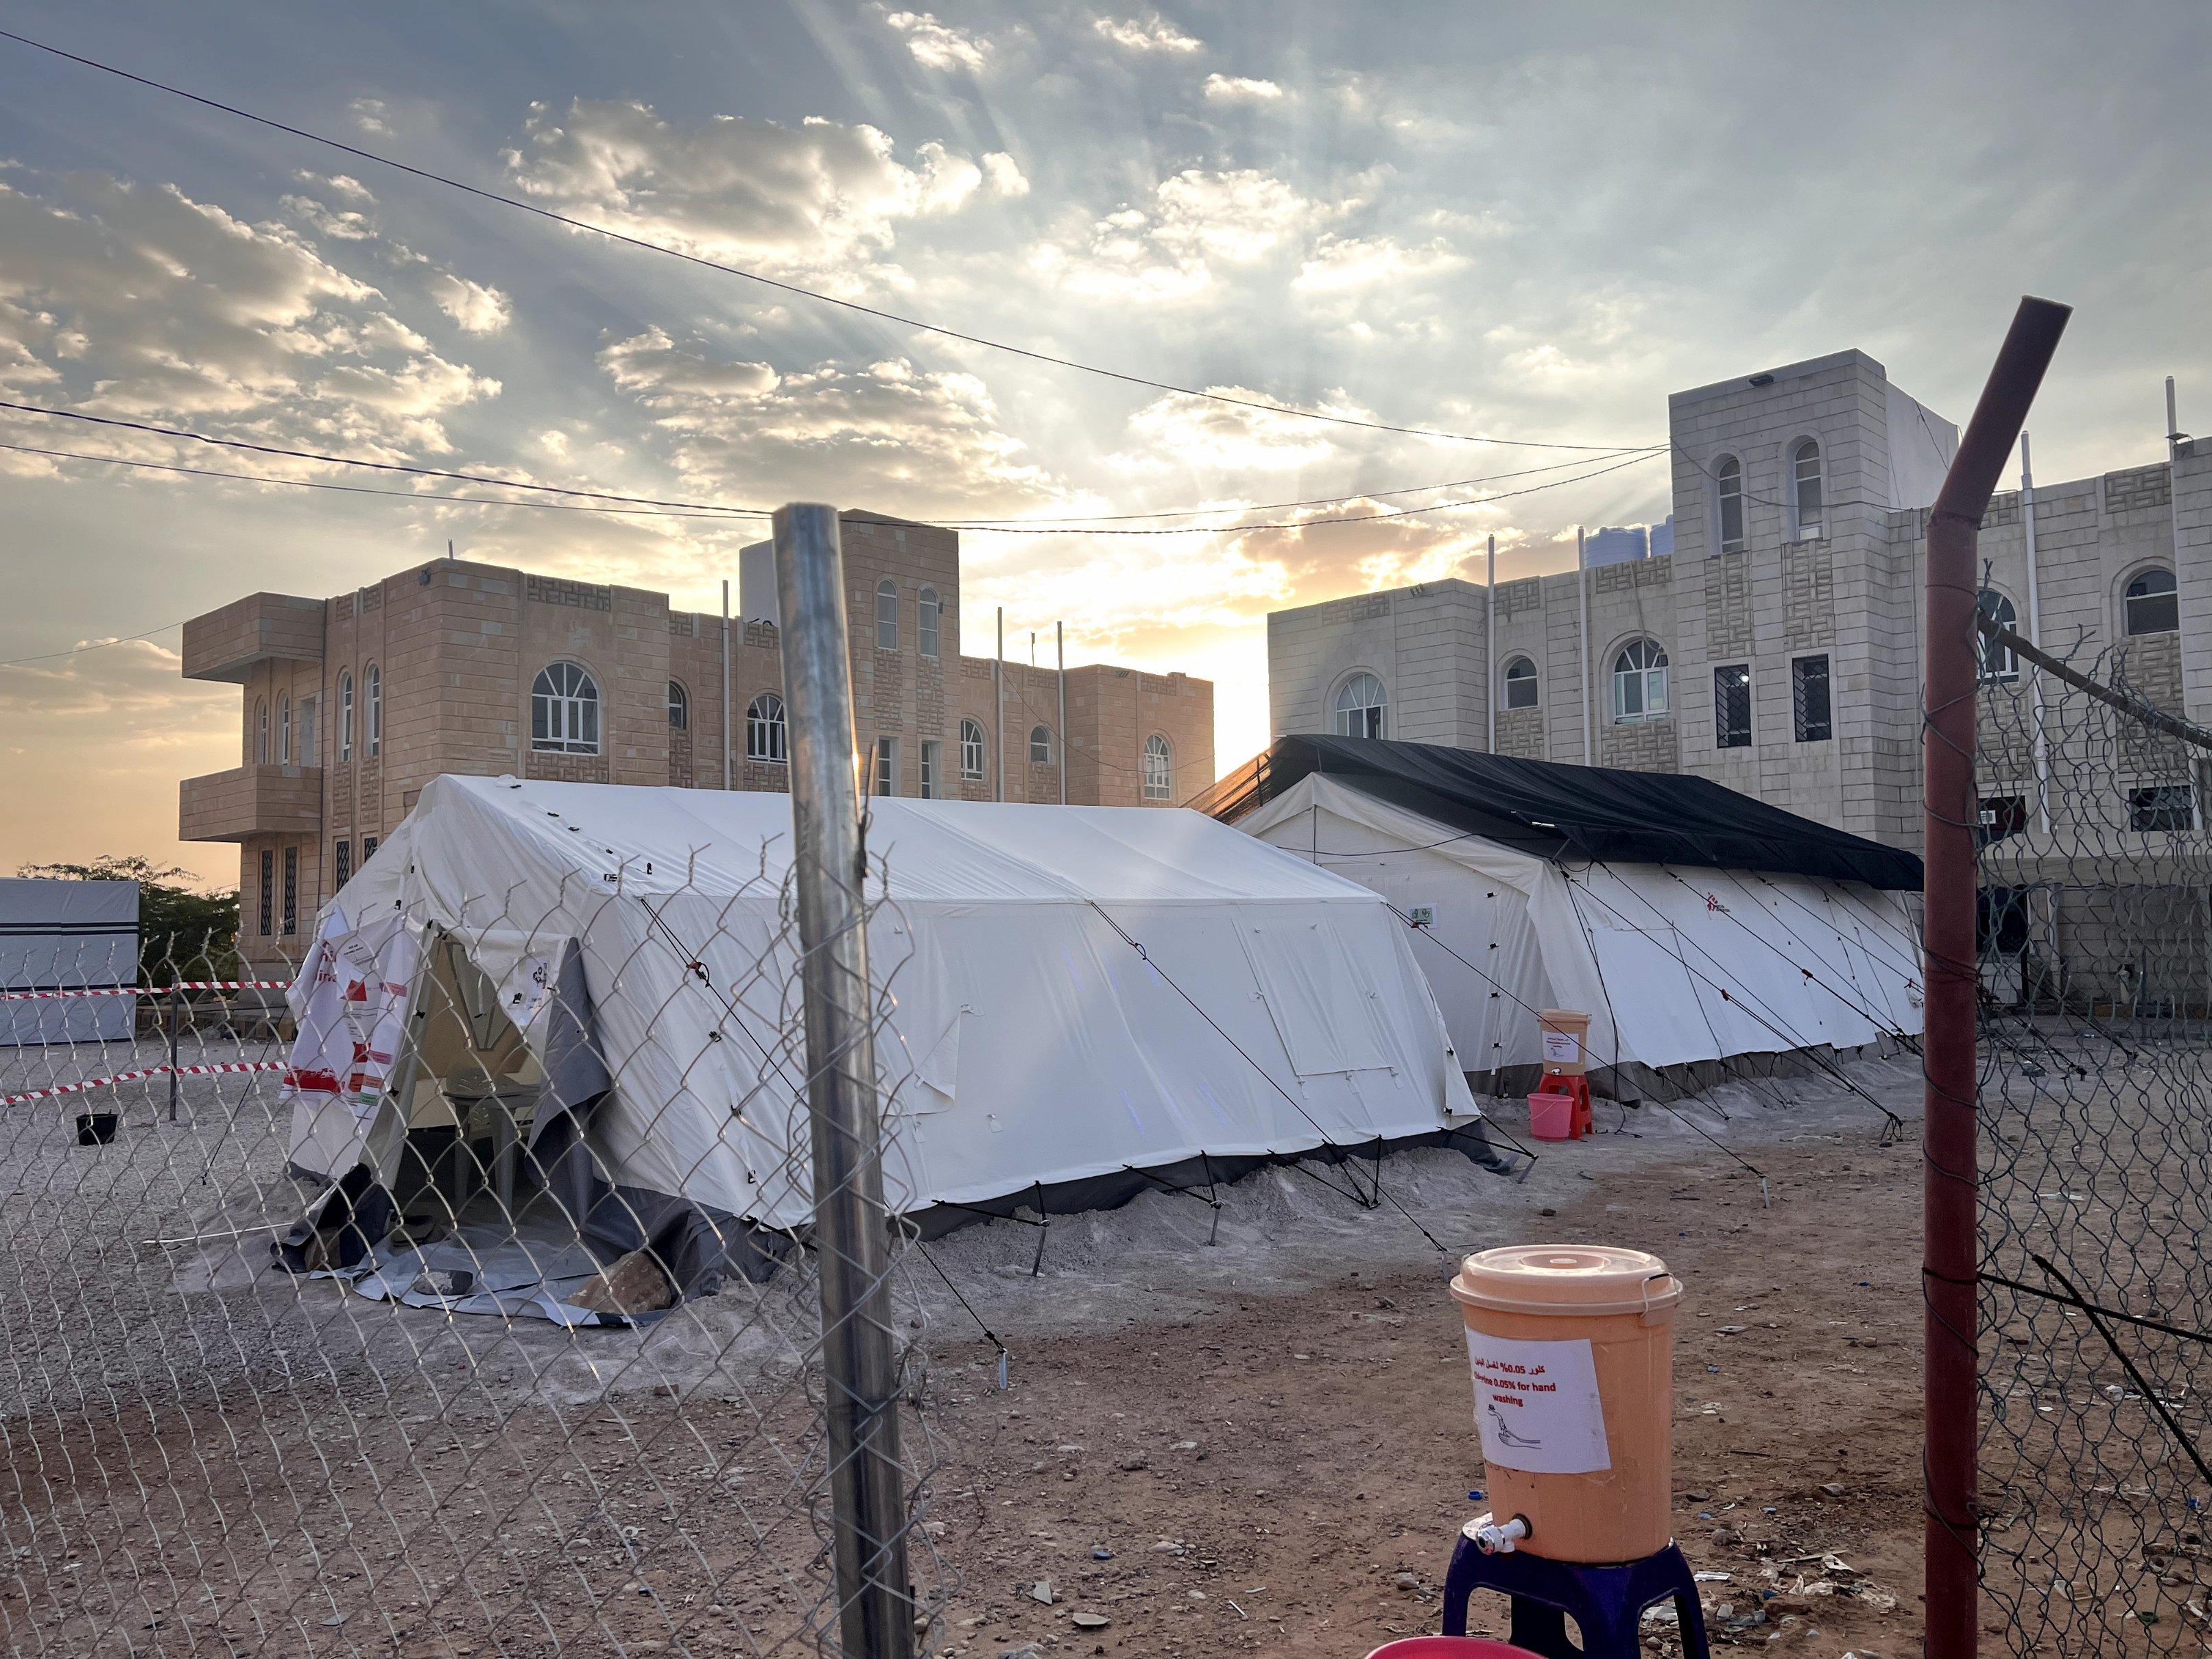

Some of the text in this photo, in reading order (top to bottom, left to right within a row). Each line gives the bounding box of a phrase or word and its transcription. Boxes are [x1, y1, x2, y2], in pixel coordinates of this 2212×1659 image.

[1528, 1365, 1545, 1375] كلور
[1494, 1378, 1516, 1389] 0.05%
[1517, 1381, 1530, 1391] for
[1532, 1382, 1556, 1392] hand
[1492, 1394, 1523, 1407] washing
